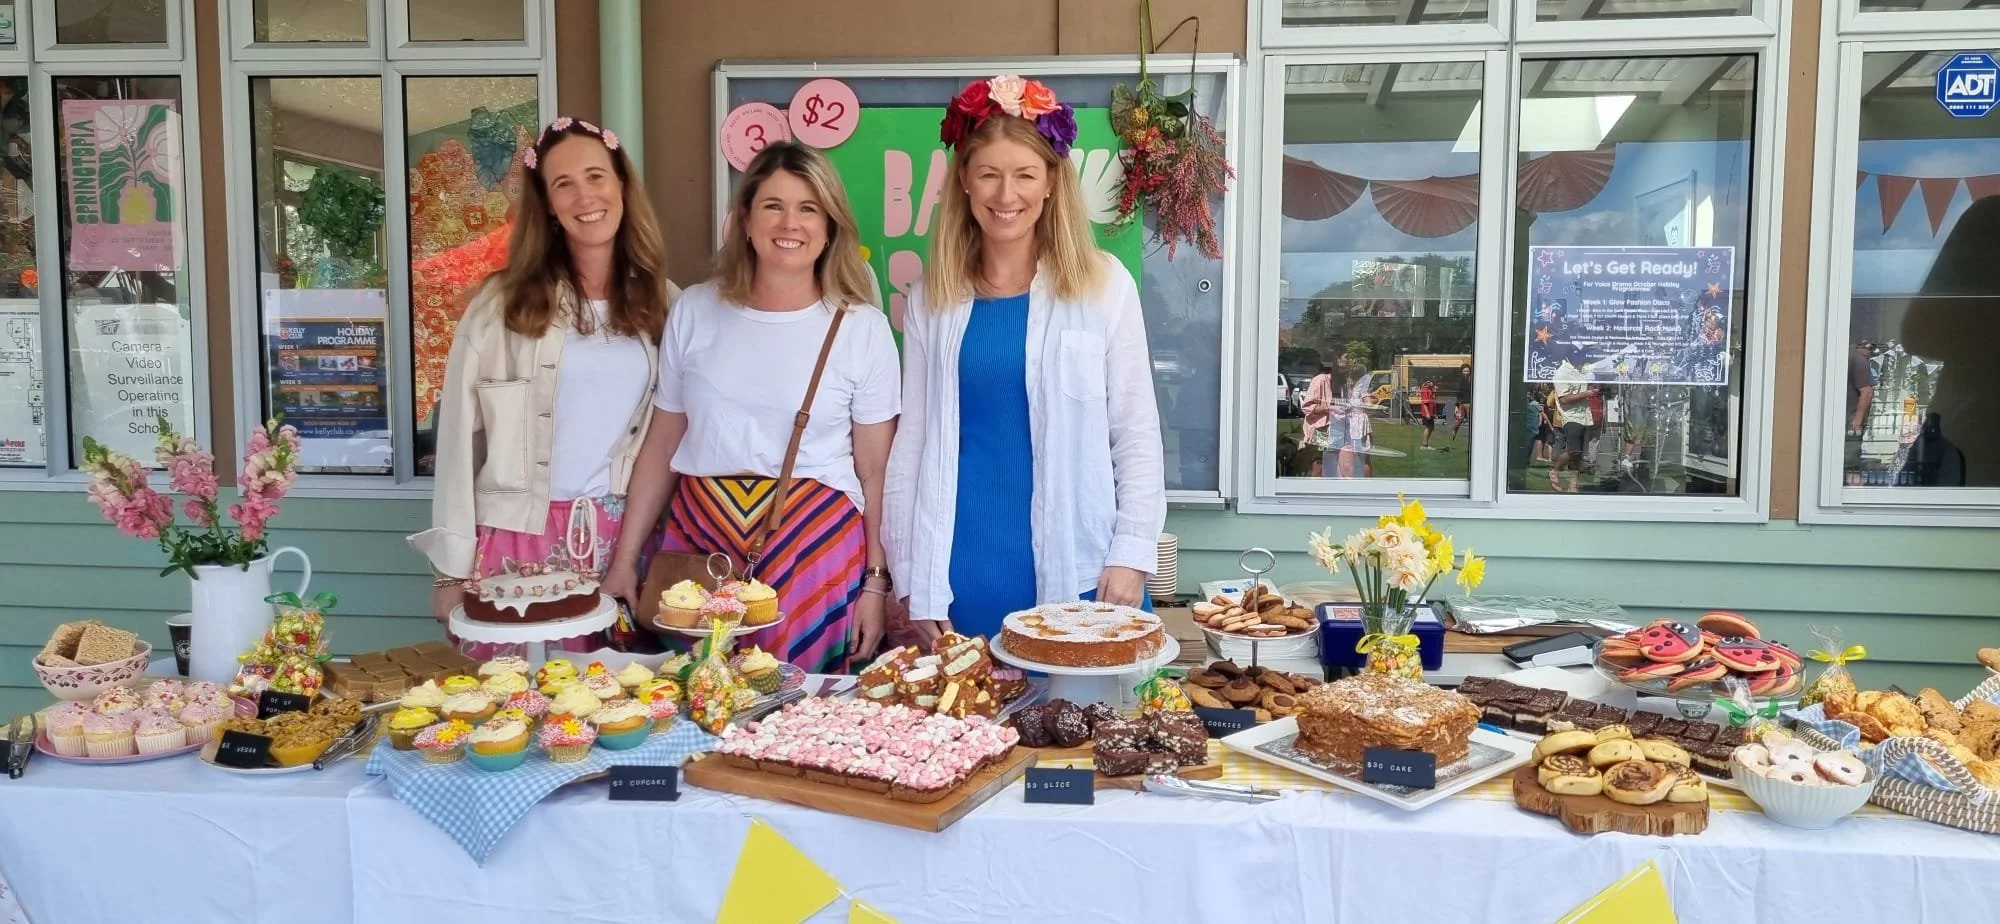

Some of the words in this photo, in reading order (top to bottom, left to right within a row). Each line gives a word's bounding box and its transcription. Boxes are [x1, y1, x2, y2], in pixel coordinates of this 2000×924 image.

[1947, 74, 1995, 96] ADT
[802, 93, 845, 131] $2
[1563, 261, 1602, 274] Let's
[1607, 261, 1637, 274] Get
[1641, 261, 1698, 278] Ready!
[337, 327, 377, 336] HOLIDAY
[317, 336, 377, 345] PROGRAMME
[112, 341, 162, 353] Camera
[125, 357, 162, 369] Video
[107, 373, 184, 385] Surveillance
[118, 389, 179, 404] Operating
[132, 406, 143, 417] in
[147, 406, 169, 418] this
[1208, 720, 1242, 729] COOKIES
[1390, 764, 1413, 773] CAKE
[629, 778, 666, 787] CUPCAKE
[1043, 781, 1071, 789] SLICE
